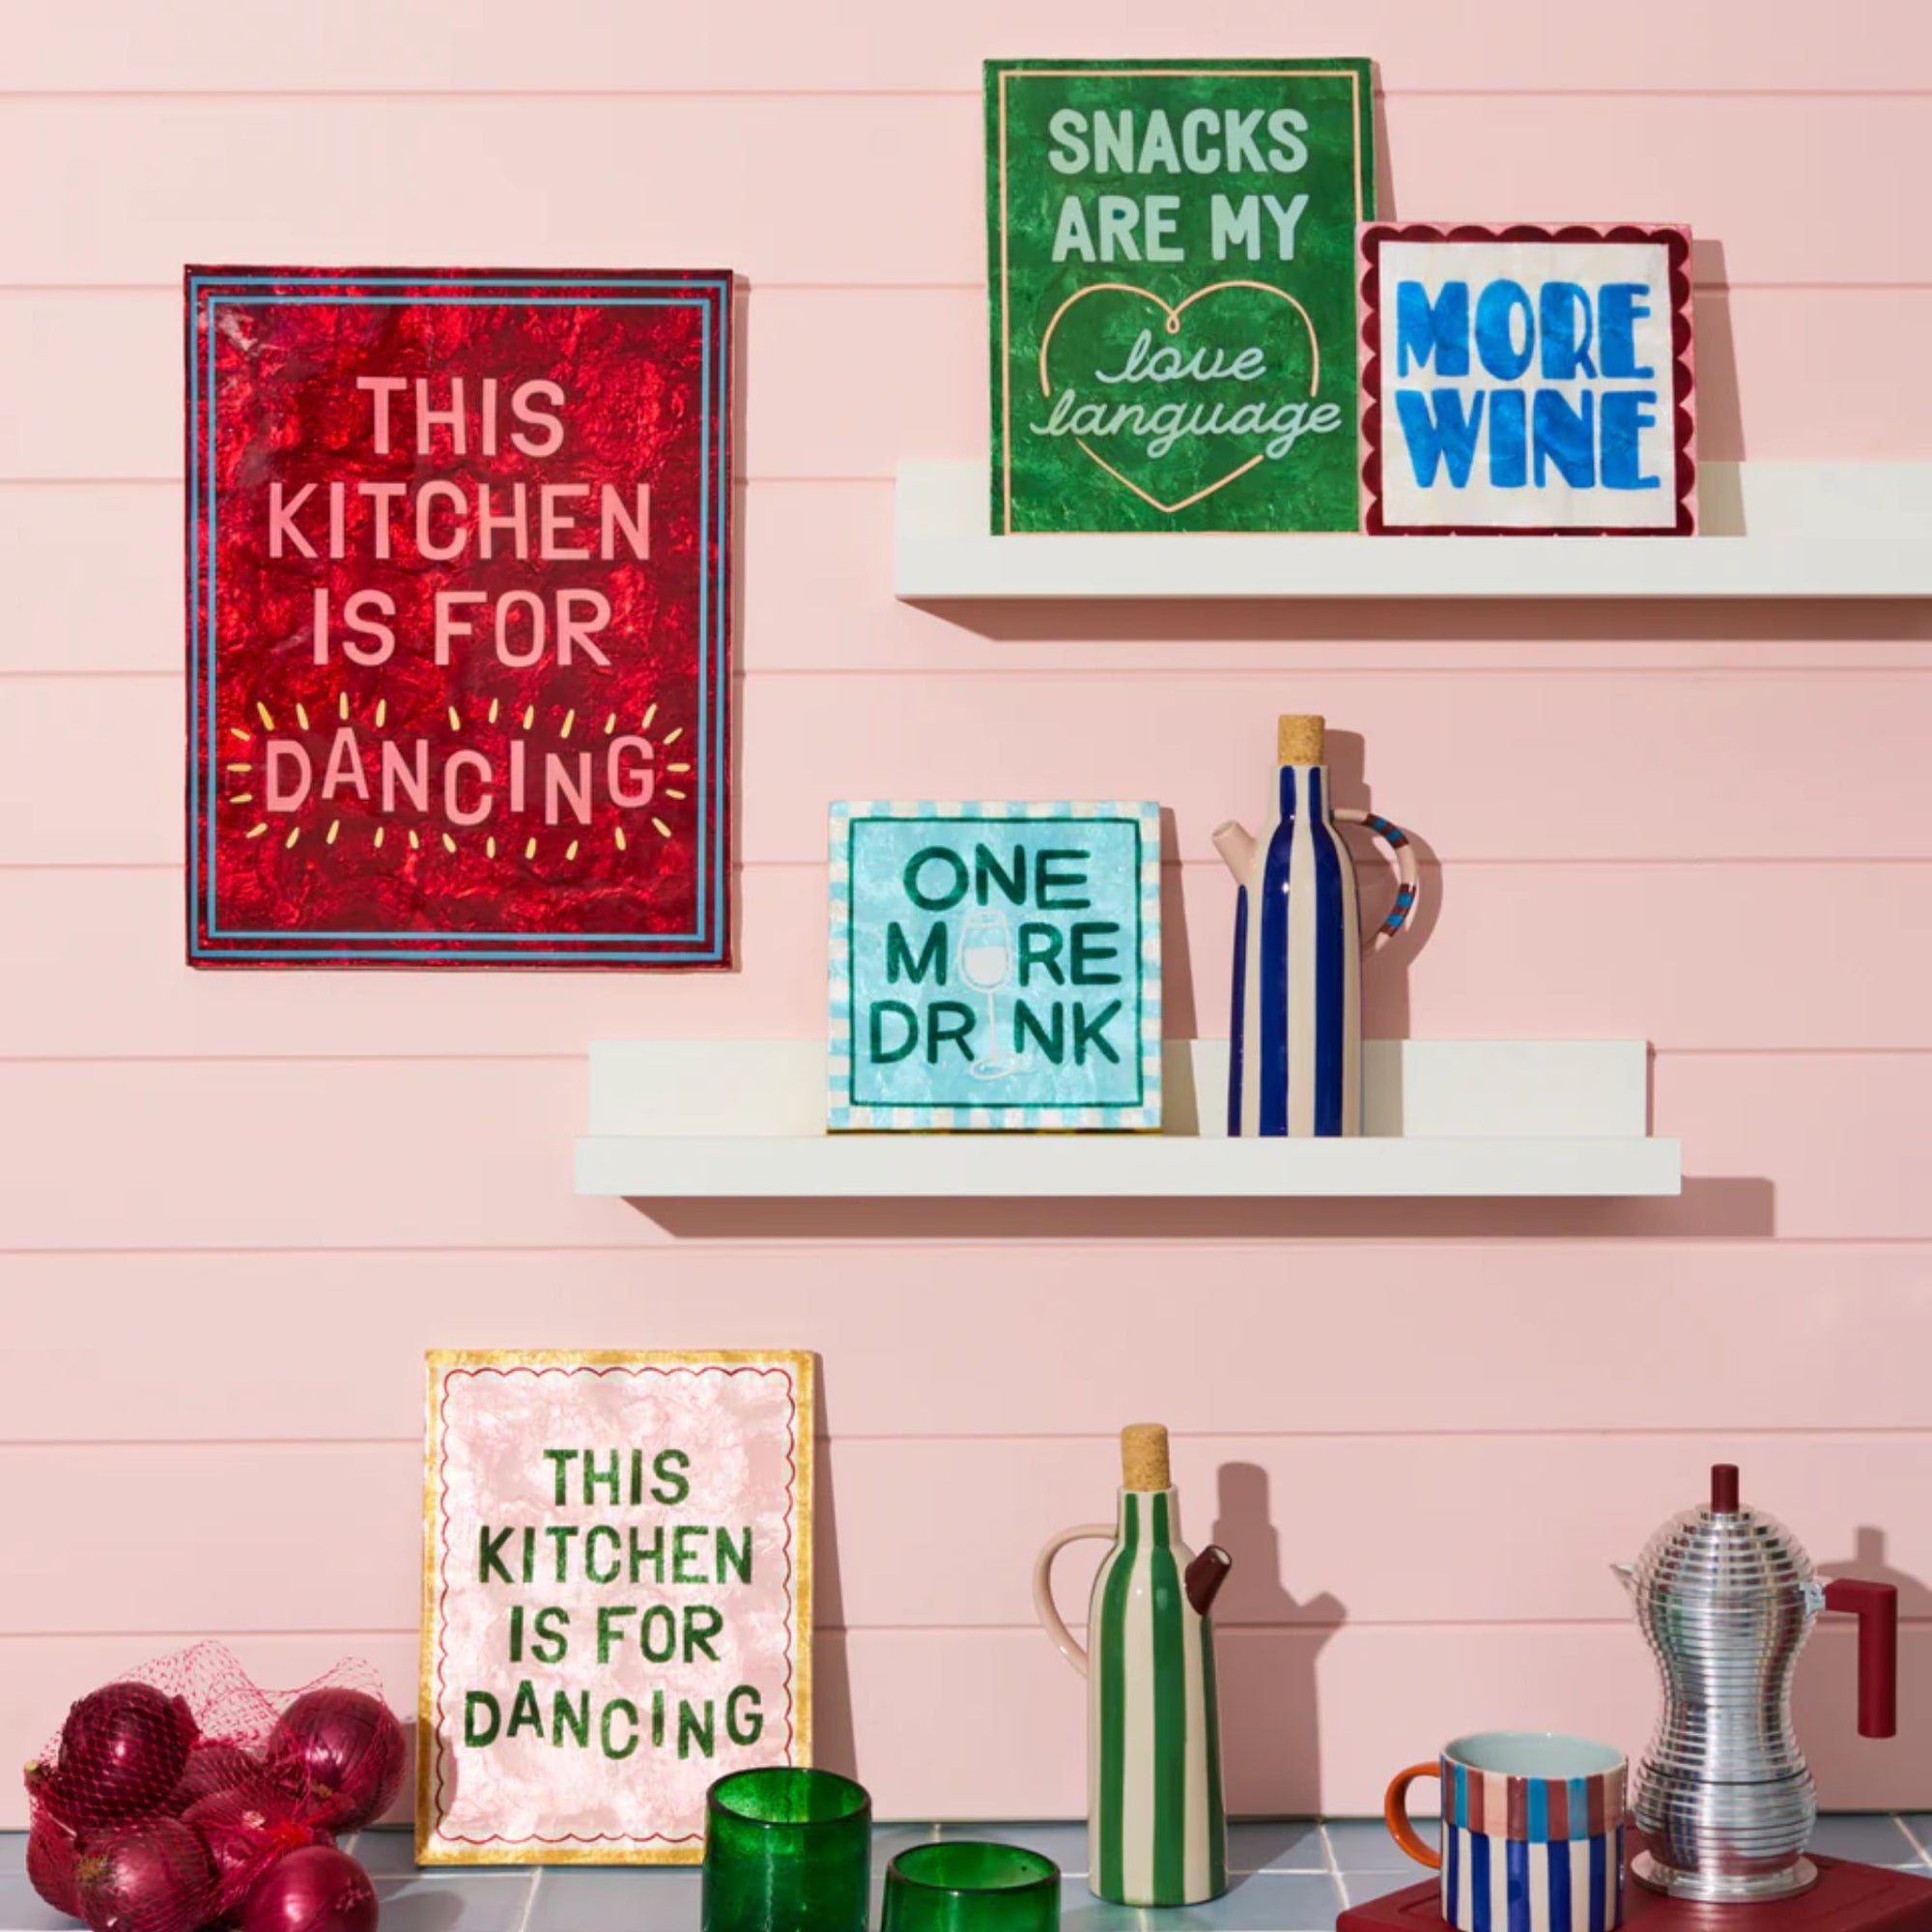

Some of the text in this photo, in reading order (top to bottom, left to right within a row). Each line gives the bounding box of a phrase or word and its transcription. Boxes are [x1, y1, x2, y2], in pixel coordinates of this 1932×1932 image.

[1047, 106, 1309, 175] SNACKS
[1051, 193, 1310, 263] ARE MY
[1094, 329, 1266, 385] love
[1397, 278, 1654, 381] MORE
[356, 376, 566, 458] THIS
[1030, 390, 1342, 459] language
[1395, 389, 1661, 490] WINE
[269, 482, 651, 561] KITCHEN
[313, 588, 612, 668] IS FOR
[265, 725, 656, 827] DANCING
[902, 842, 1092, 911] ONE
[886, 920, 1122, 987] MRE
[868, 999, 1122, 1065] DRNK
[542, 1448, 690, 1507] THIS
[477, 1524, 753, 1585] KITCHEN
[508, 1603, 724, 1664] IS FOR
[464, 1679, 764, 1761] DANCING
